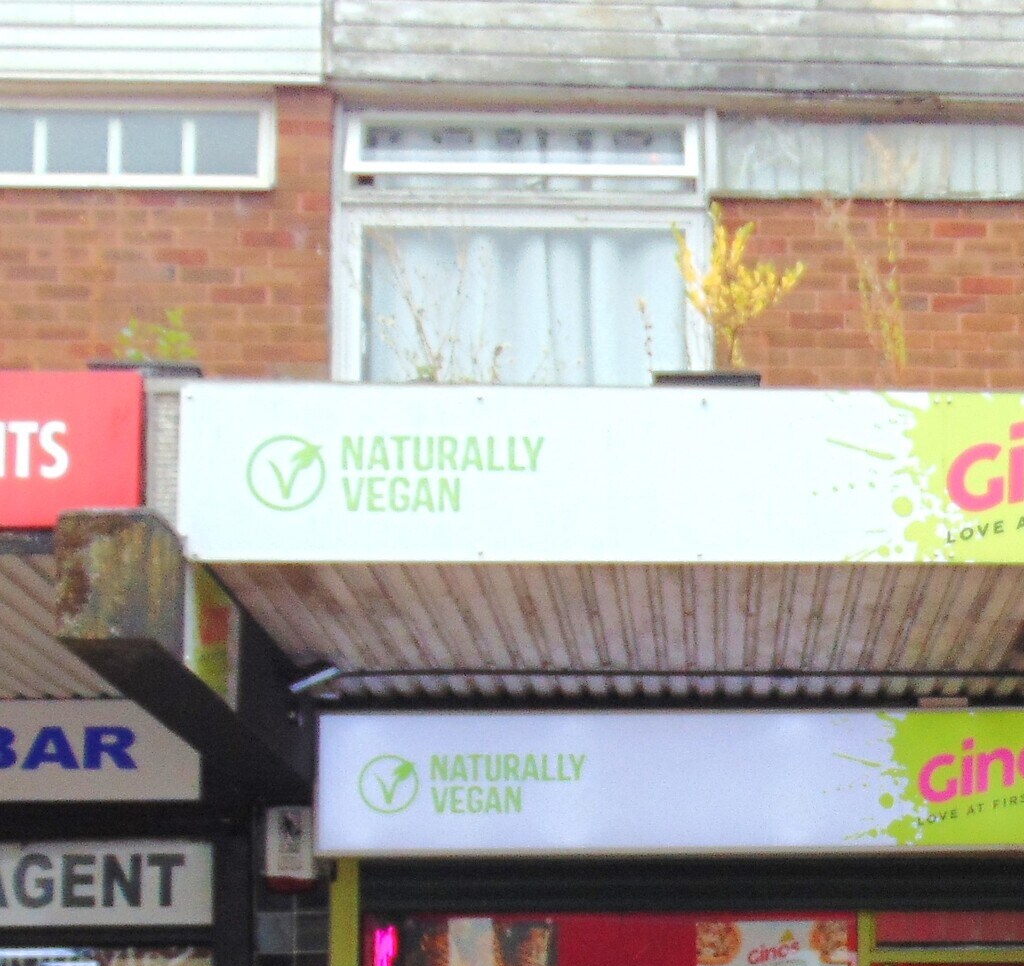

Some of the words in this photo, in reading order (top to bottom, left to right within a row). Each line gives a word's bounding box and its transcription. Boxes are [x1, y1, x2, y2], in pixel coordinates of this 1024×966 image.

[342, 435, 545, 471] NATURALLY
[342, 477, 460, 512] VEGAN
[947, 520, 1005, 544] LOVE
[430, 753, 586, 781] NATURALLY
[431, 785, 523, 814] VEGAN
[917, 808, 958, 826] LOVE
[966, 803, 985, 816] AT
[0, 853, 185, 908] GENT
